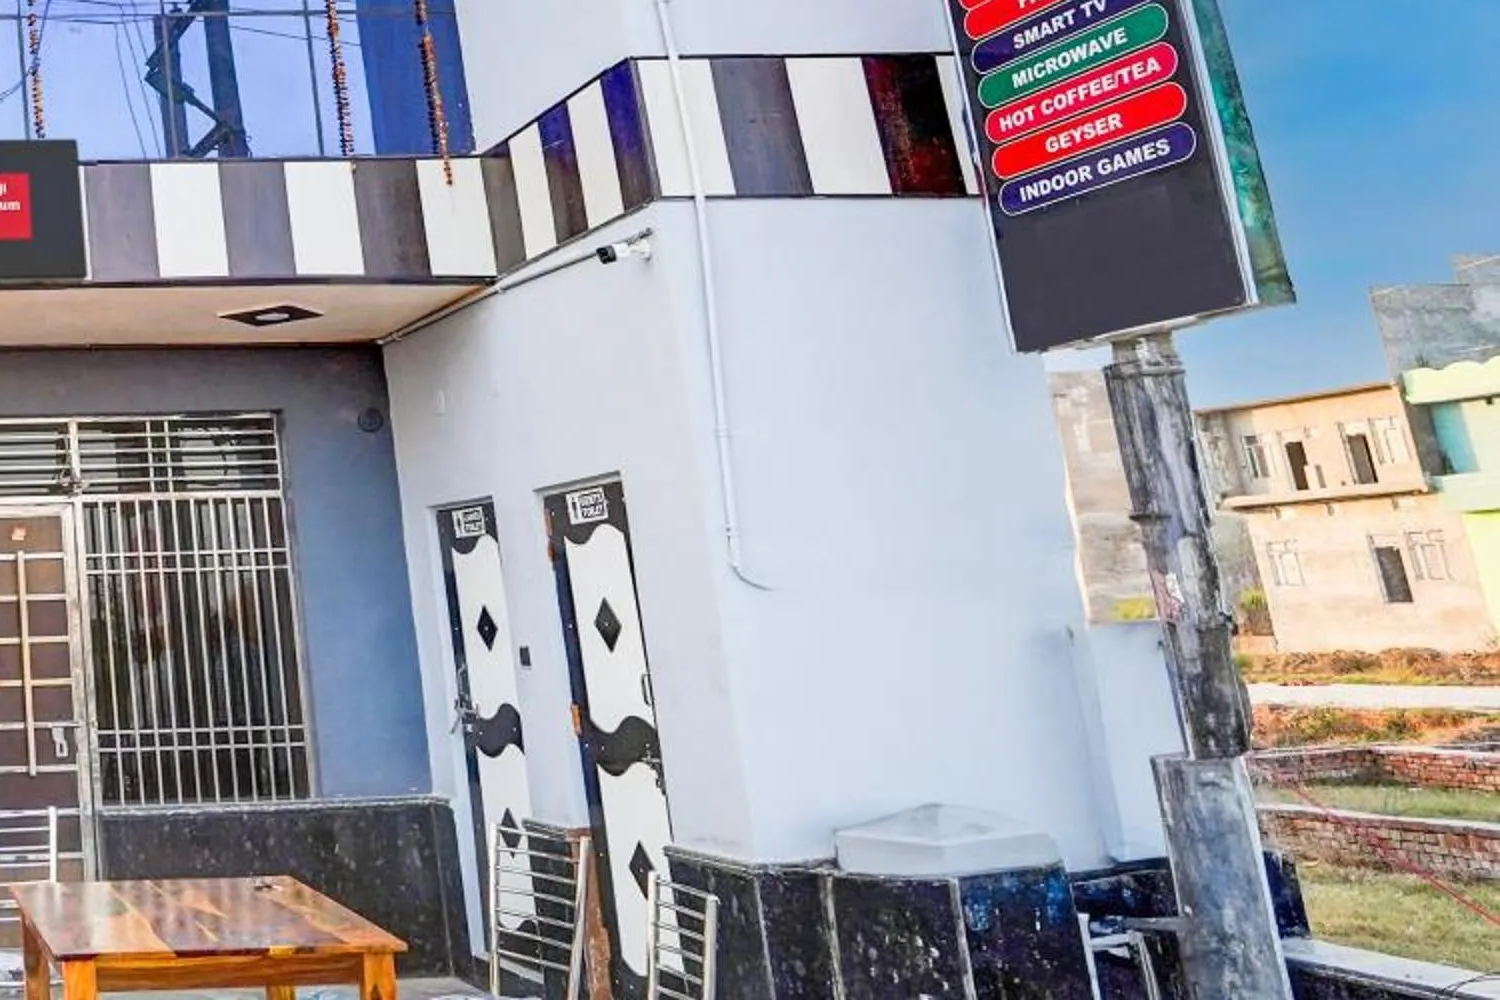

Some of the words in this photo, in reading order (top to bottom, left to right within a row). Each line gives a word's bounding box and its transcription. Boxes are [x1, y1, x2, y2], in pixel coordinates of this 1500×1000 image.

[1011, 27, 1129, 89] MICROWAVE
[1013, 11, 1076, 50] SMART
[999, 107, 1037, 133] HOT
[1041, 56, 1162, 115] COFFEE/TEA
[1045, 112, 1123, 154] GEYSER
[1020, 164, 1093, 203] INDOOR
[1097, 139, 1171, 175] GAMES
